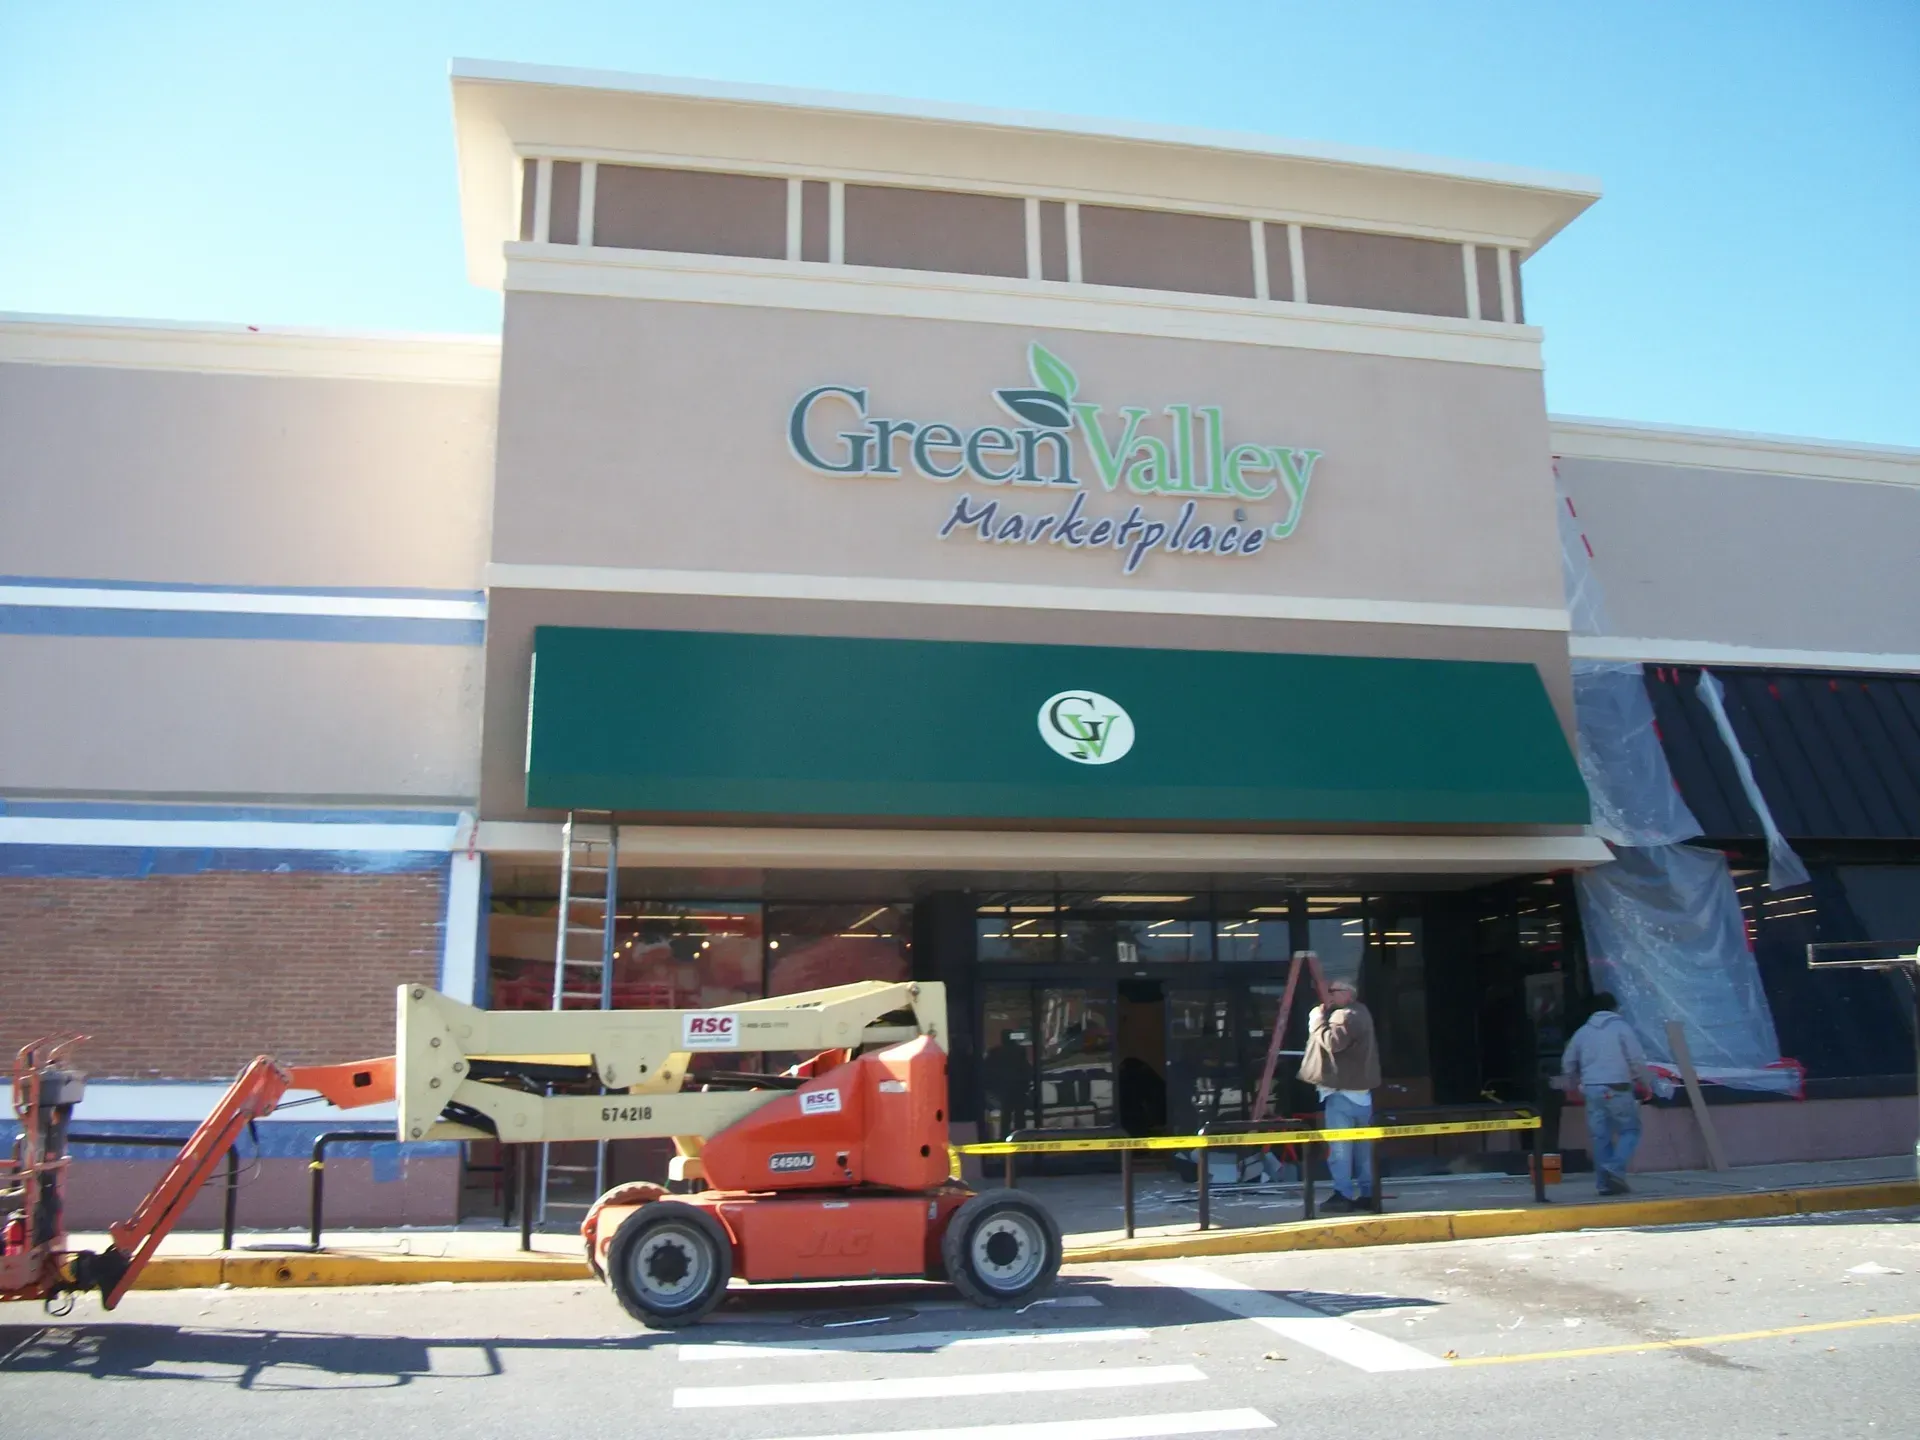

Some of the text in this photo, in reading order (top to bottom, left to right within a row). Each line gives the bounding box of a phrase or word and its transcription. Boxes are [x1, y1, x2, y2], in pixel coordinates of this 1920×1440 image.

[788, 385, 1321, 538] Green Valley
[938, 492, 1268, 575] Marketplace
[690, 1017, 733, 1033] RSC
[806, 1092, 835, 1105] RSC
[601, 1106, 653, 1121] 674218
[770, 1155, 815, 1169] E450AJ
